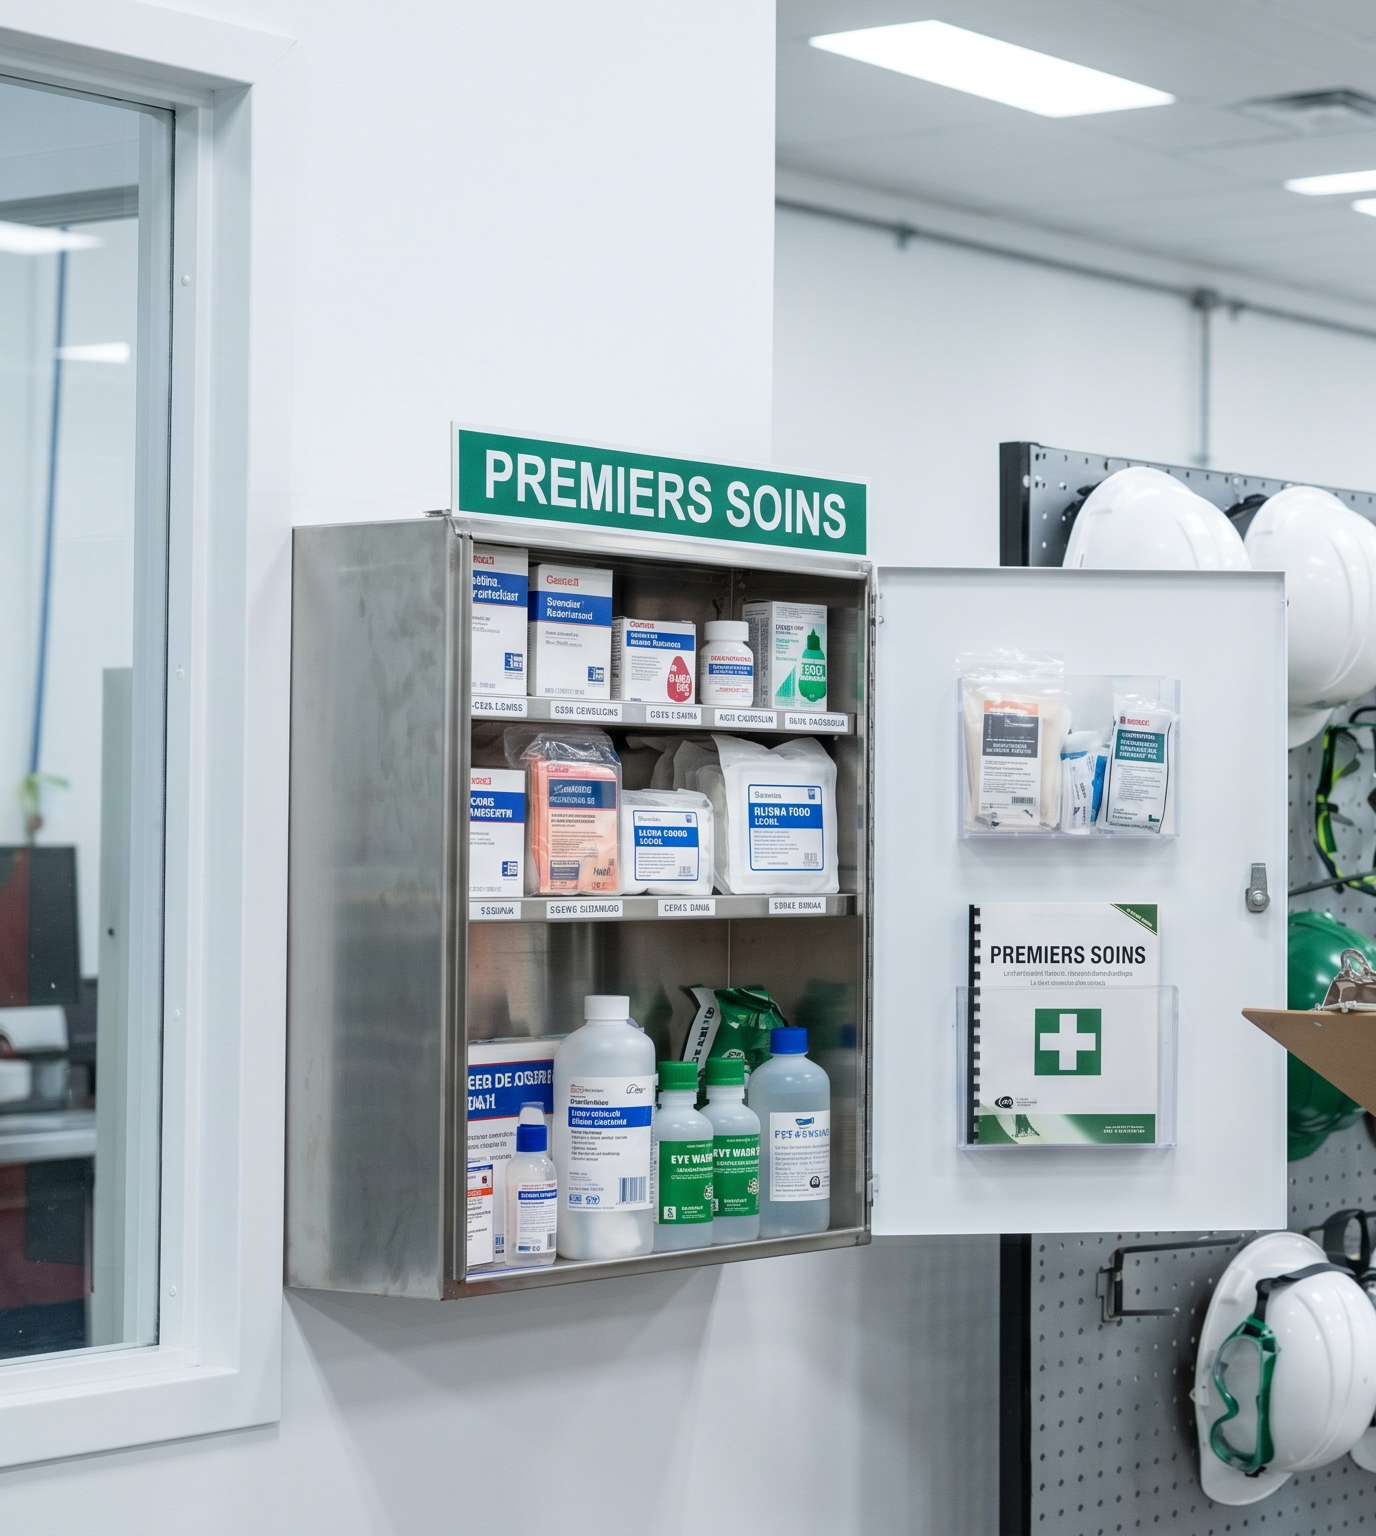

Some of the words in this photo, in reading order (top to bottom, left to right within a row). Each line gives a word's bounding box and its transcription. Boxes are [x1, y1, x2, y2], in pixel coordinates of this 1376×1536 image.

[485, 448, 713, 524] PREMIERS
[726, 481, 847, 539] SOINS
[990, 945, 1085, 964] PREMIERS
[1090, 945, 1146, 965] SOINS
[494, 1072, 513, 1089] DE
